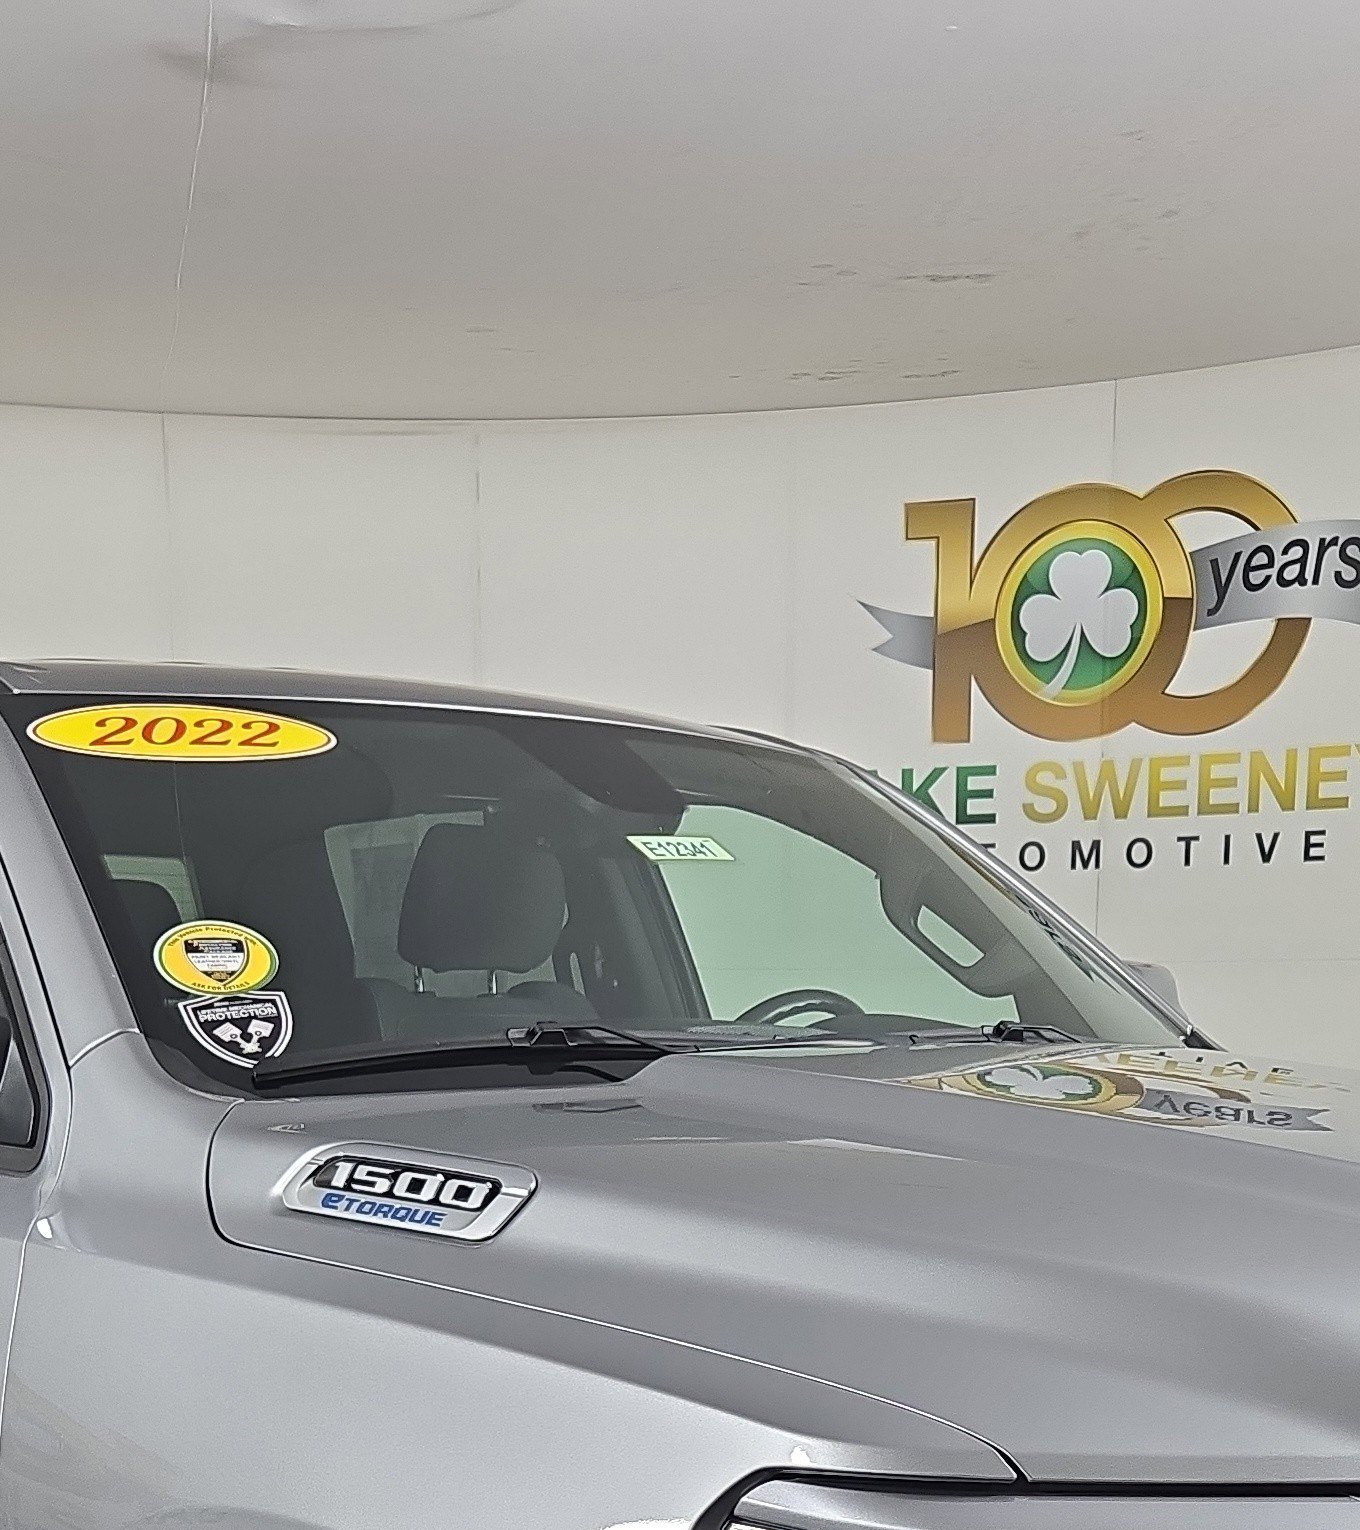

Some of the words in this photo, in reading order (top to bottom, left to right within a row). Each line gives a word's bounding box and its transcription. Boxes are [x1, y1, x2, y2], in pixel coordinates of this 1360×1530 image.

[904, 469, 1313, 744] 100
[90, 716, 281, 747] 2022
[868, 764, 997, 825] KE
[980, 829, 1328, 872] OMOTIVE
[199, 1006, 278, 1023] PROTECTION
[329, 1161, 492, 1209] 1500
